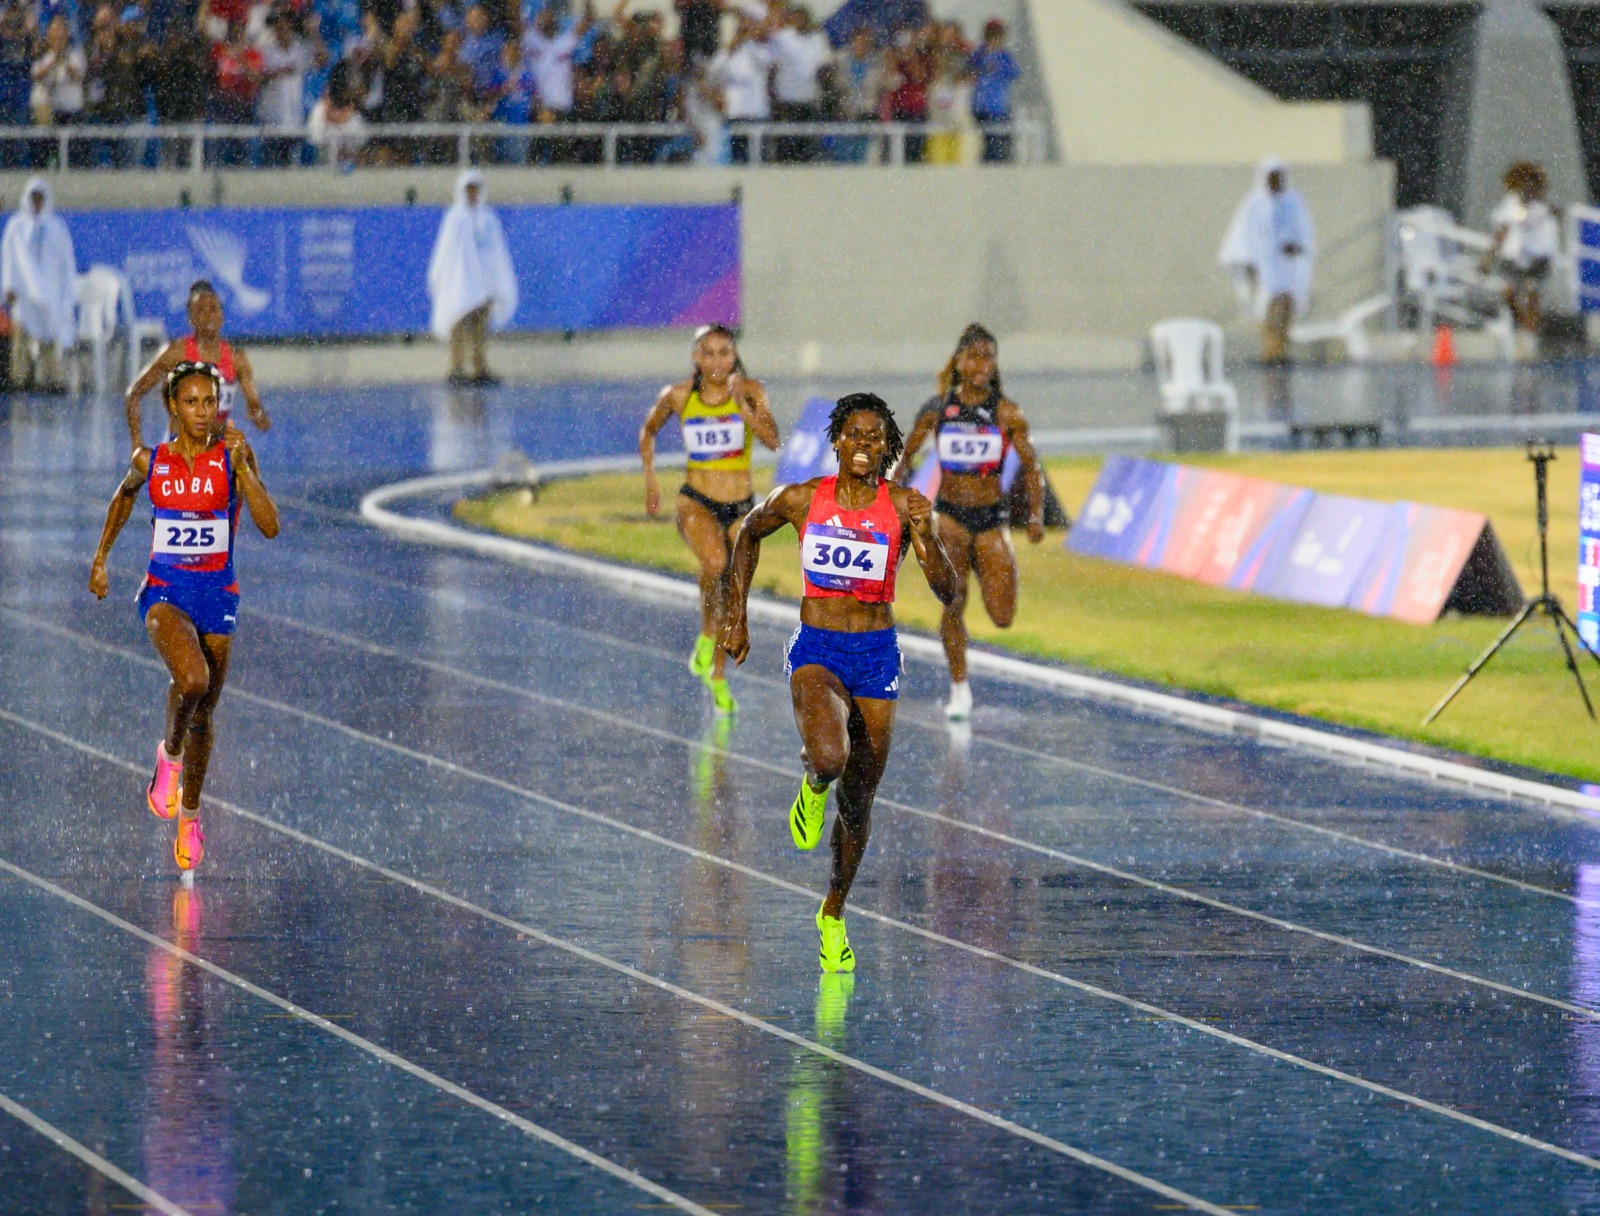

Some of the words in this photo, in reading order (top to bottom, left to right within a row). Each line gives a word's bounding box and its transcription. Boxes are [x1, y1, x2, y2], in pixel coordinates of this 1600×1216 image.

[695, 429, 731, 446] 183
[950, 440, 991, 456] 557
[162, 478, 214, 496] CUBA
[167, 526, 215, 548] 225
[813, 542, 873, 571] 304
